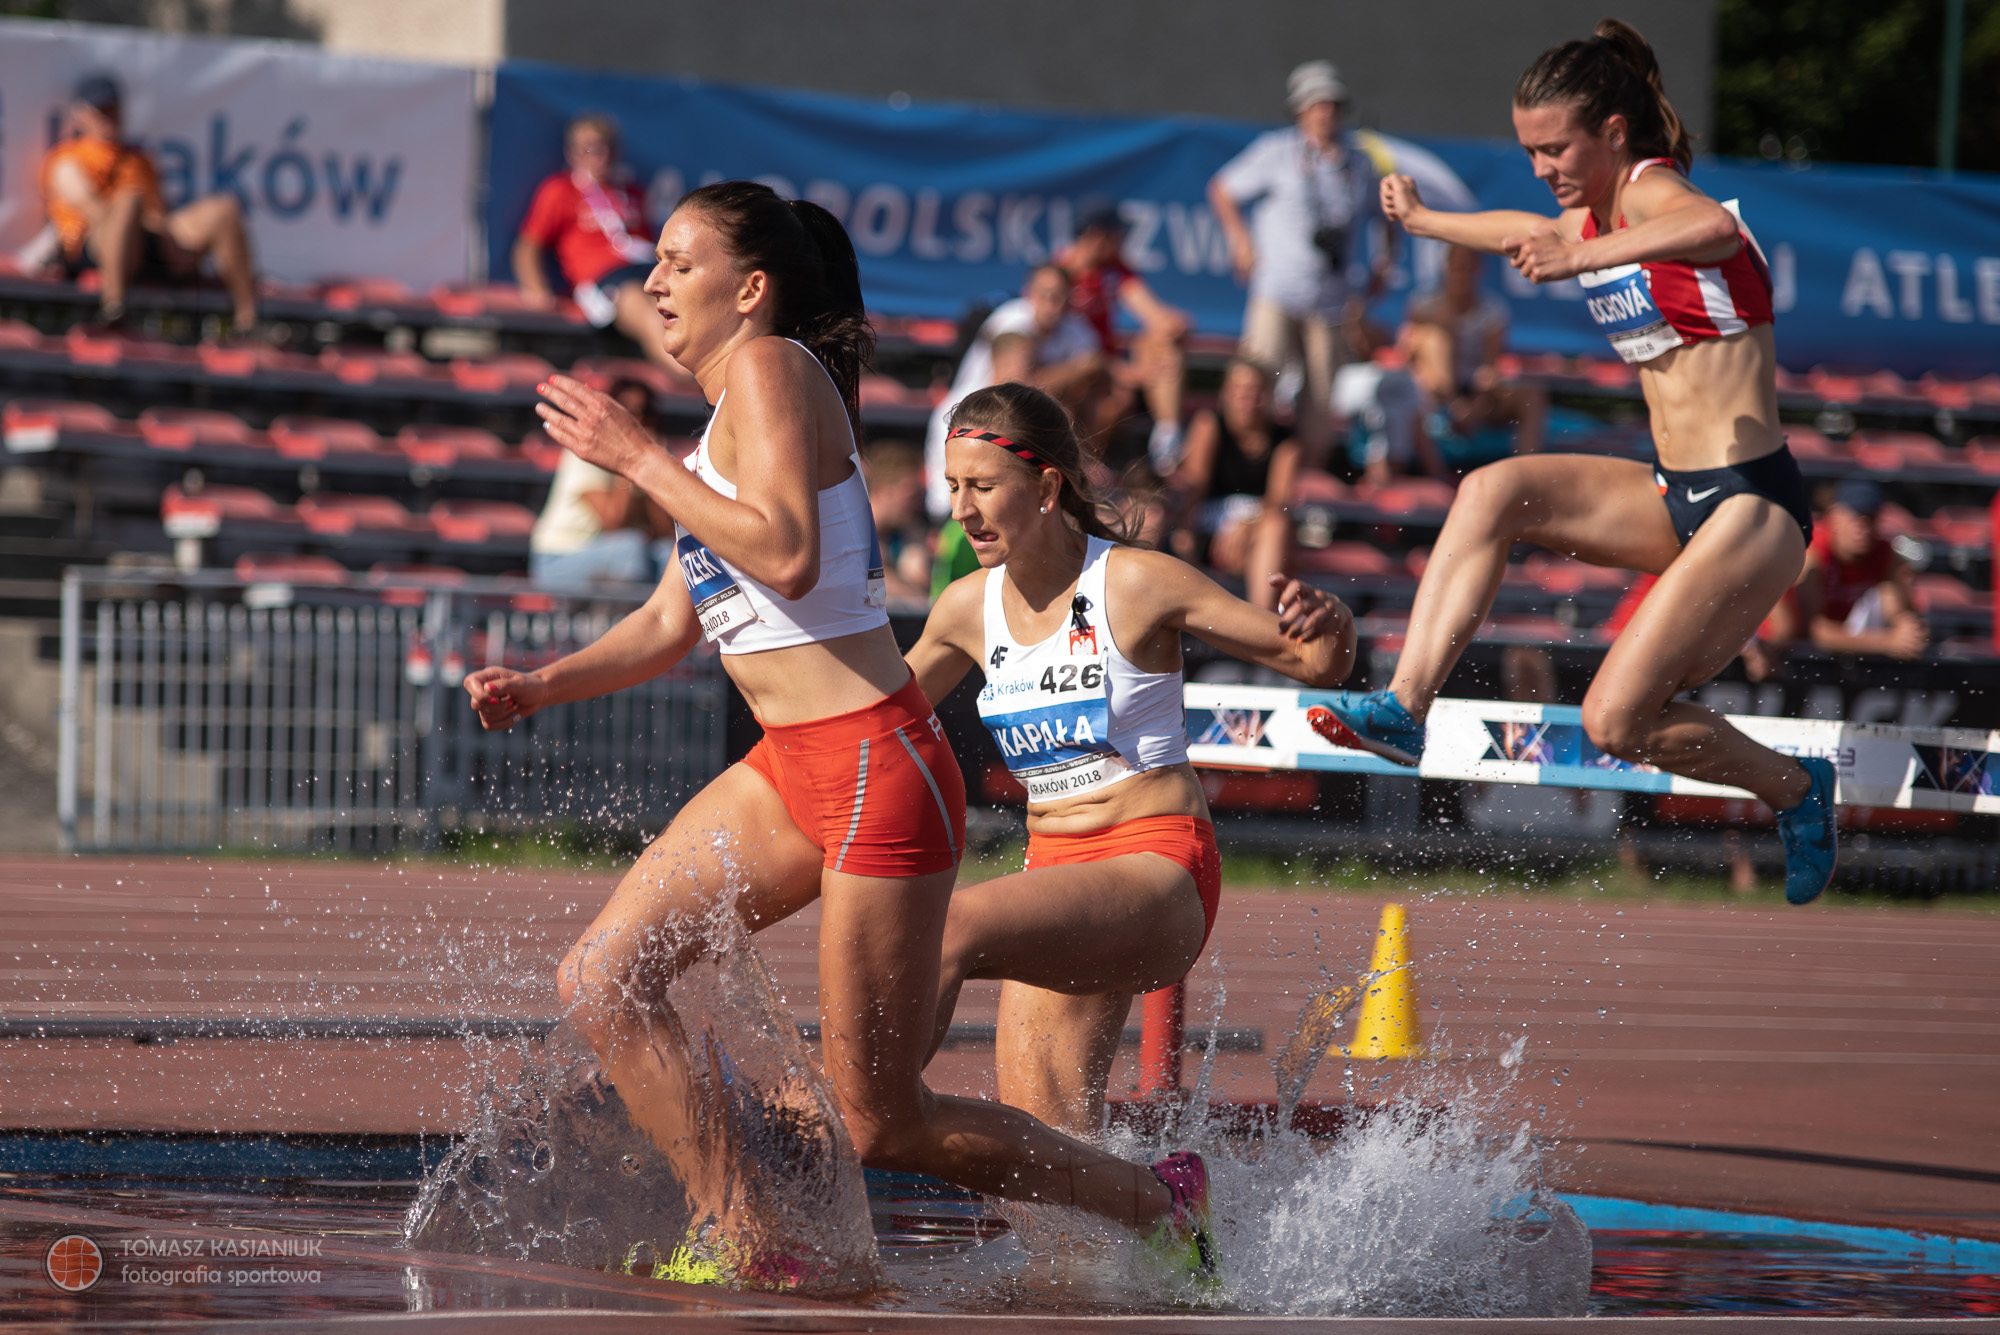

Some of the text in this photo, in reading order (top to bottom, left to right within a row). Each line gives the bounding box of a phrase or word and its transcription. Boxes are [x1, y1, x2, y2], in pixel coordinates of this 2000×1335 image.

[997, 679, 1034, 696] Kraków
[1040, 664, 1103, 694] 426
[995, 715, 1097, 757] KAPAŁA
[1030, 777, 1069, 796] KRAKÓW
[1071, 770, 1102, 788] 2018
